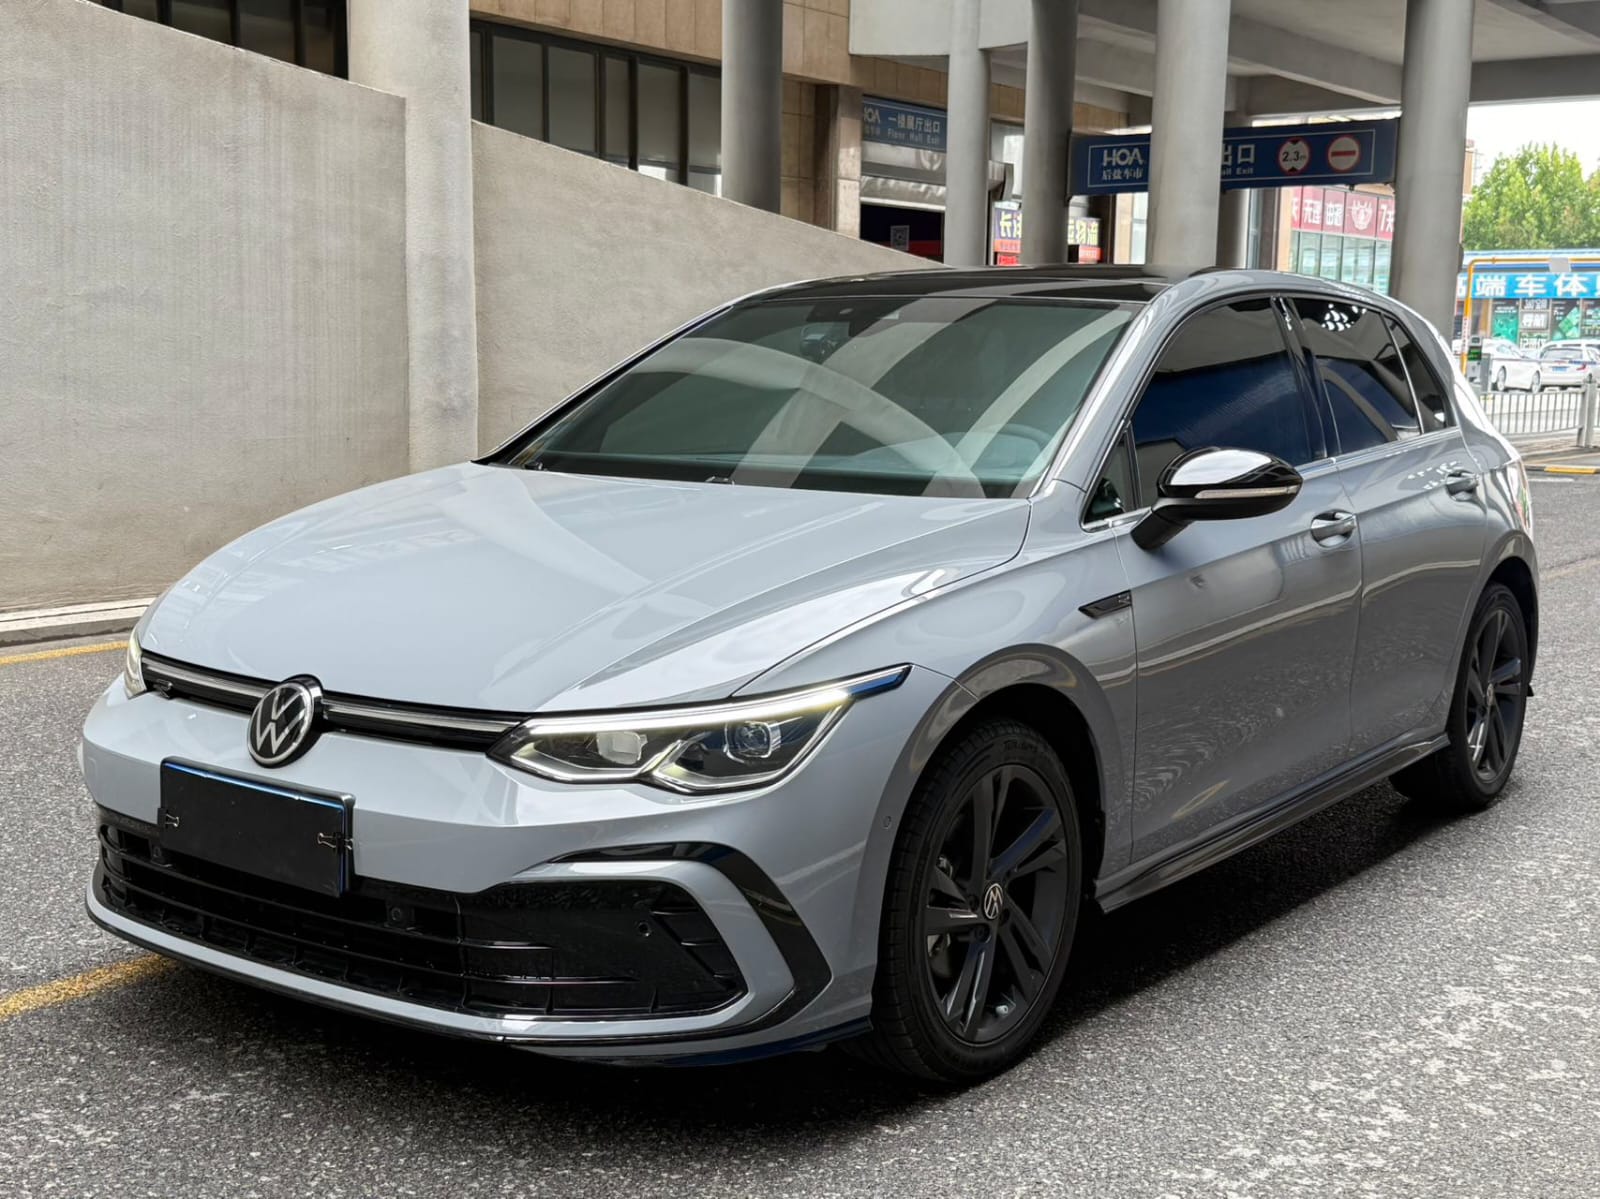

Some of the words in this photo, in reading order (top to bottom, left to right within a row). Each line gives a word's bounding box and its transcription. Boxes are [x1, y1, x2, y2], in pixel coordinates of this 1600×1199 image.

[1103, 148, 1143, 166] HOA
[1457, 273, 1600, 298] 端车体
